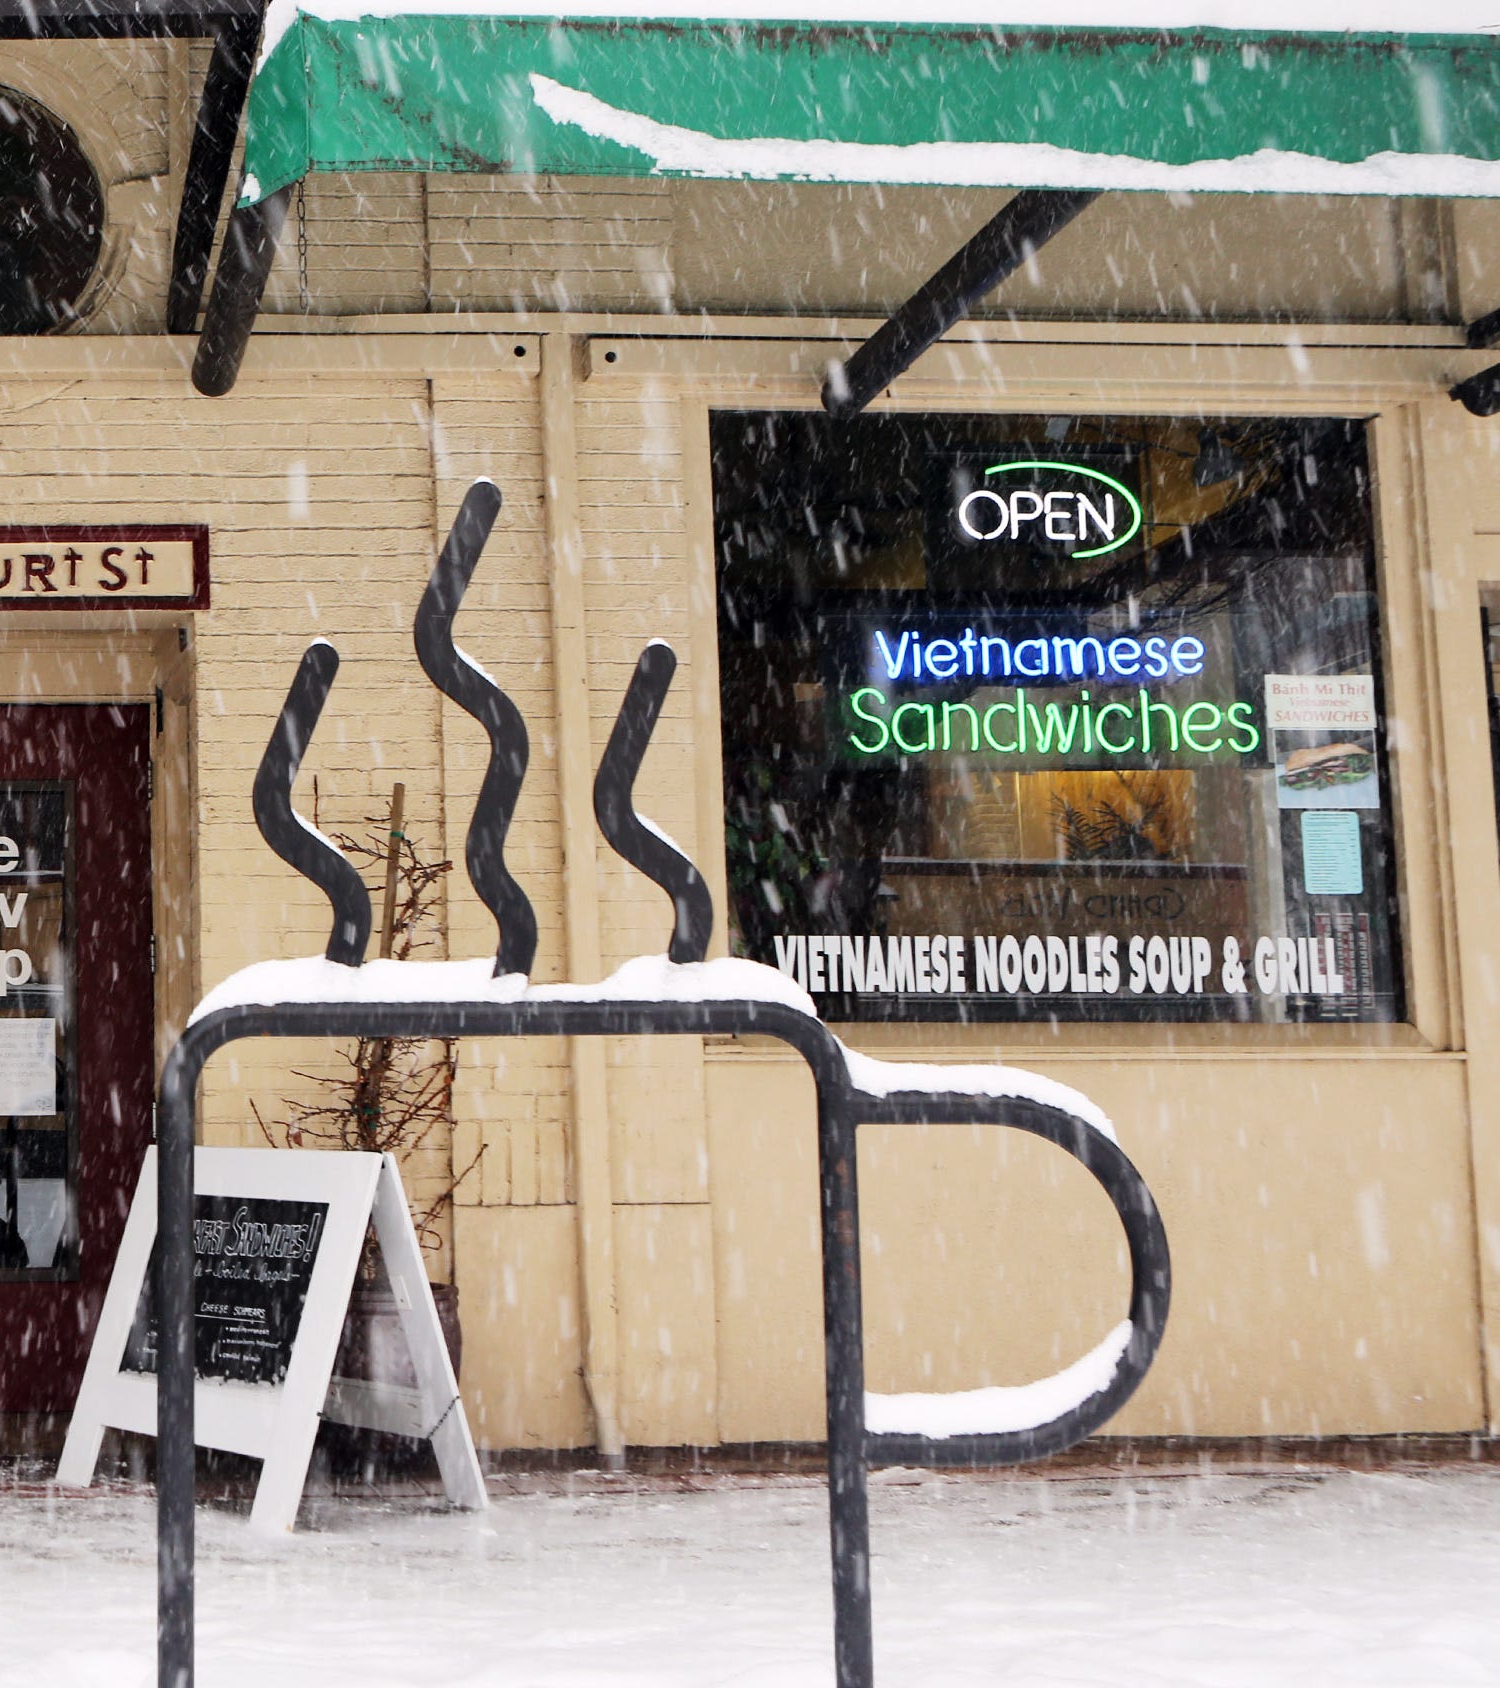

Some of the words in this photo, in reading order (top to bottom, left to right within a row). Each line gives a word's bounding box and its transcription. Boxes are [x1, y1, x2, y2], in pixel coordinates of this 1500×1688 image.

[958, 490, 1116, 541] OPEN
[873, 628, 1206, 681] Vietnamese
[850, 686, 1261, 755] Sandwiches
[1274, 710, 1370, 722] SANDWICHES
[773, 935, 967, 993] VIETNAMESE
[974, 934, 1120, 994] NOODLES
[1128, 934, 1212, 994] SOUP
[1221, 935, 1248, 993] &
[1254, 935, 1344, 994] GRILL
[201, 1302, 229, 1314] CHEESE
